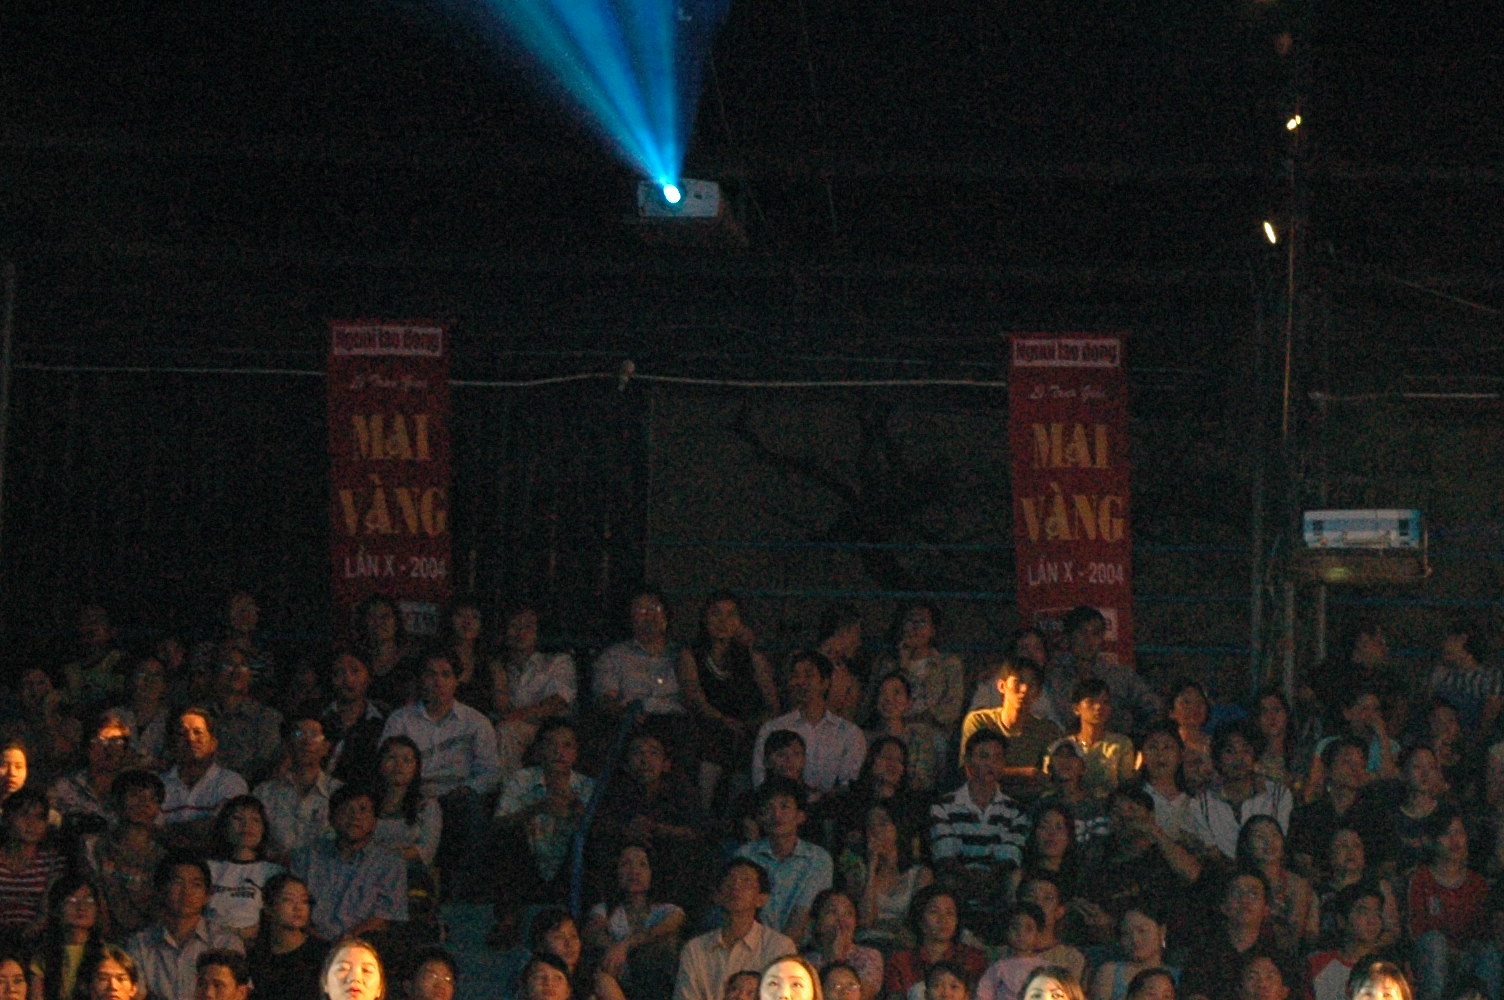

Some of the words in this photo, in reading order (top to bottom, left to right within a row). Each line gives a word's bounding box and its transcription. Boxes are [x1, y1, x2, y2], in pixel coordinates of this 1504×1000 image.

[352, 413, 430, 460] MAI
[1032, 423, 1110, 469] MAI
[339, 473, 447, 536] VÀNG
[1020, 482, 1125, 543] VÀNG
[379, 554, 396, 577] X
[409, 556, 446, 579] 2004
[1063, 562, 1074, 582] X
[1088, 562, 1124, 585] 2004
